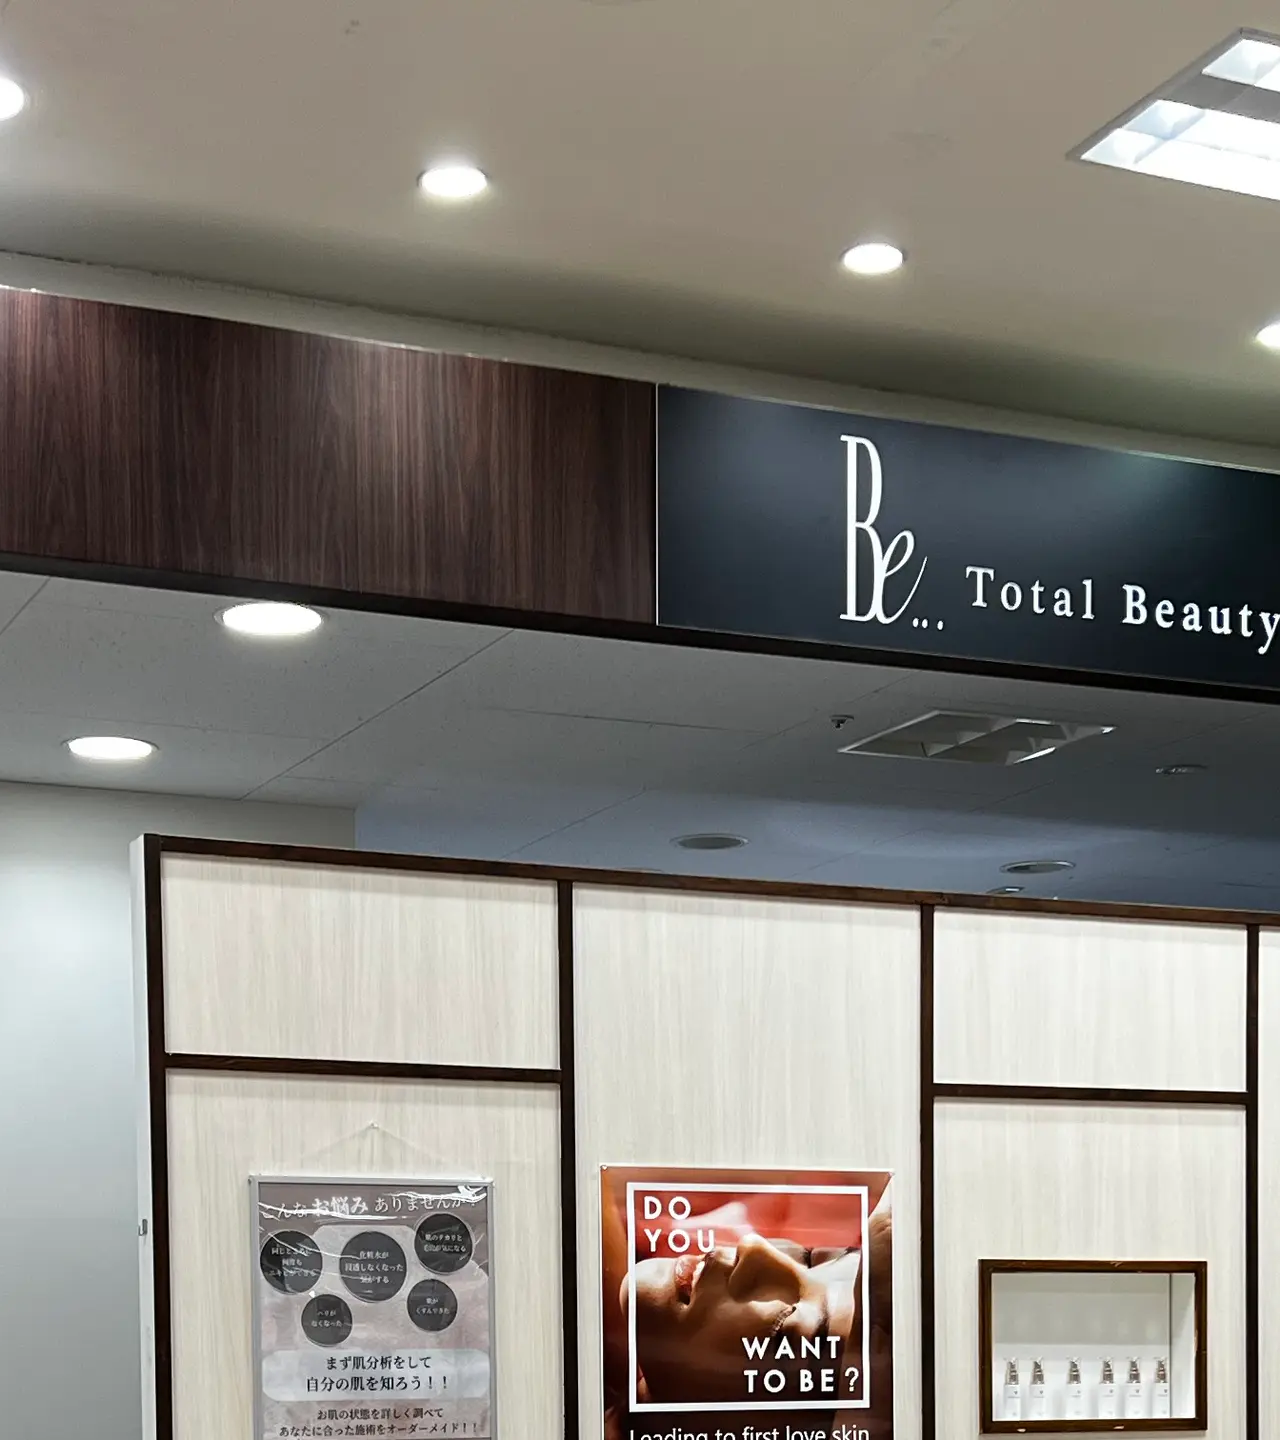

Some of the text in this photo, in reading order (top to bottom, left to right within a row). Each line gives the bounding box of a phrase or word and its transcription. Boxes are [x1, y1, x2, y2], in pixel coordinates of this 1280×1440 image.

[965, 565, 1095, 620] Total
[644, 1196, 691, 1220] DO
[644, 1228, 715, 1253] YOU
[742, 1335, 841, 1360] WANT
[326, 1356, 432, 1371] まず肌分析をして
[744, 1369, 786, 1393] TO
